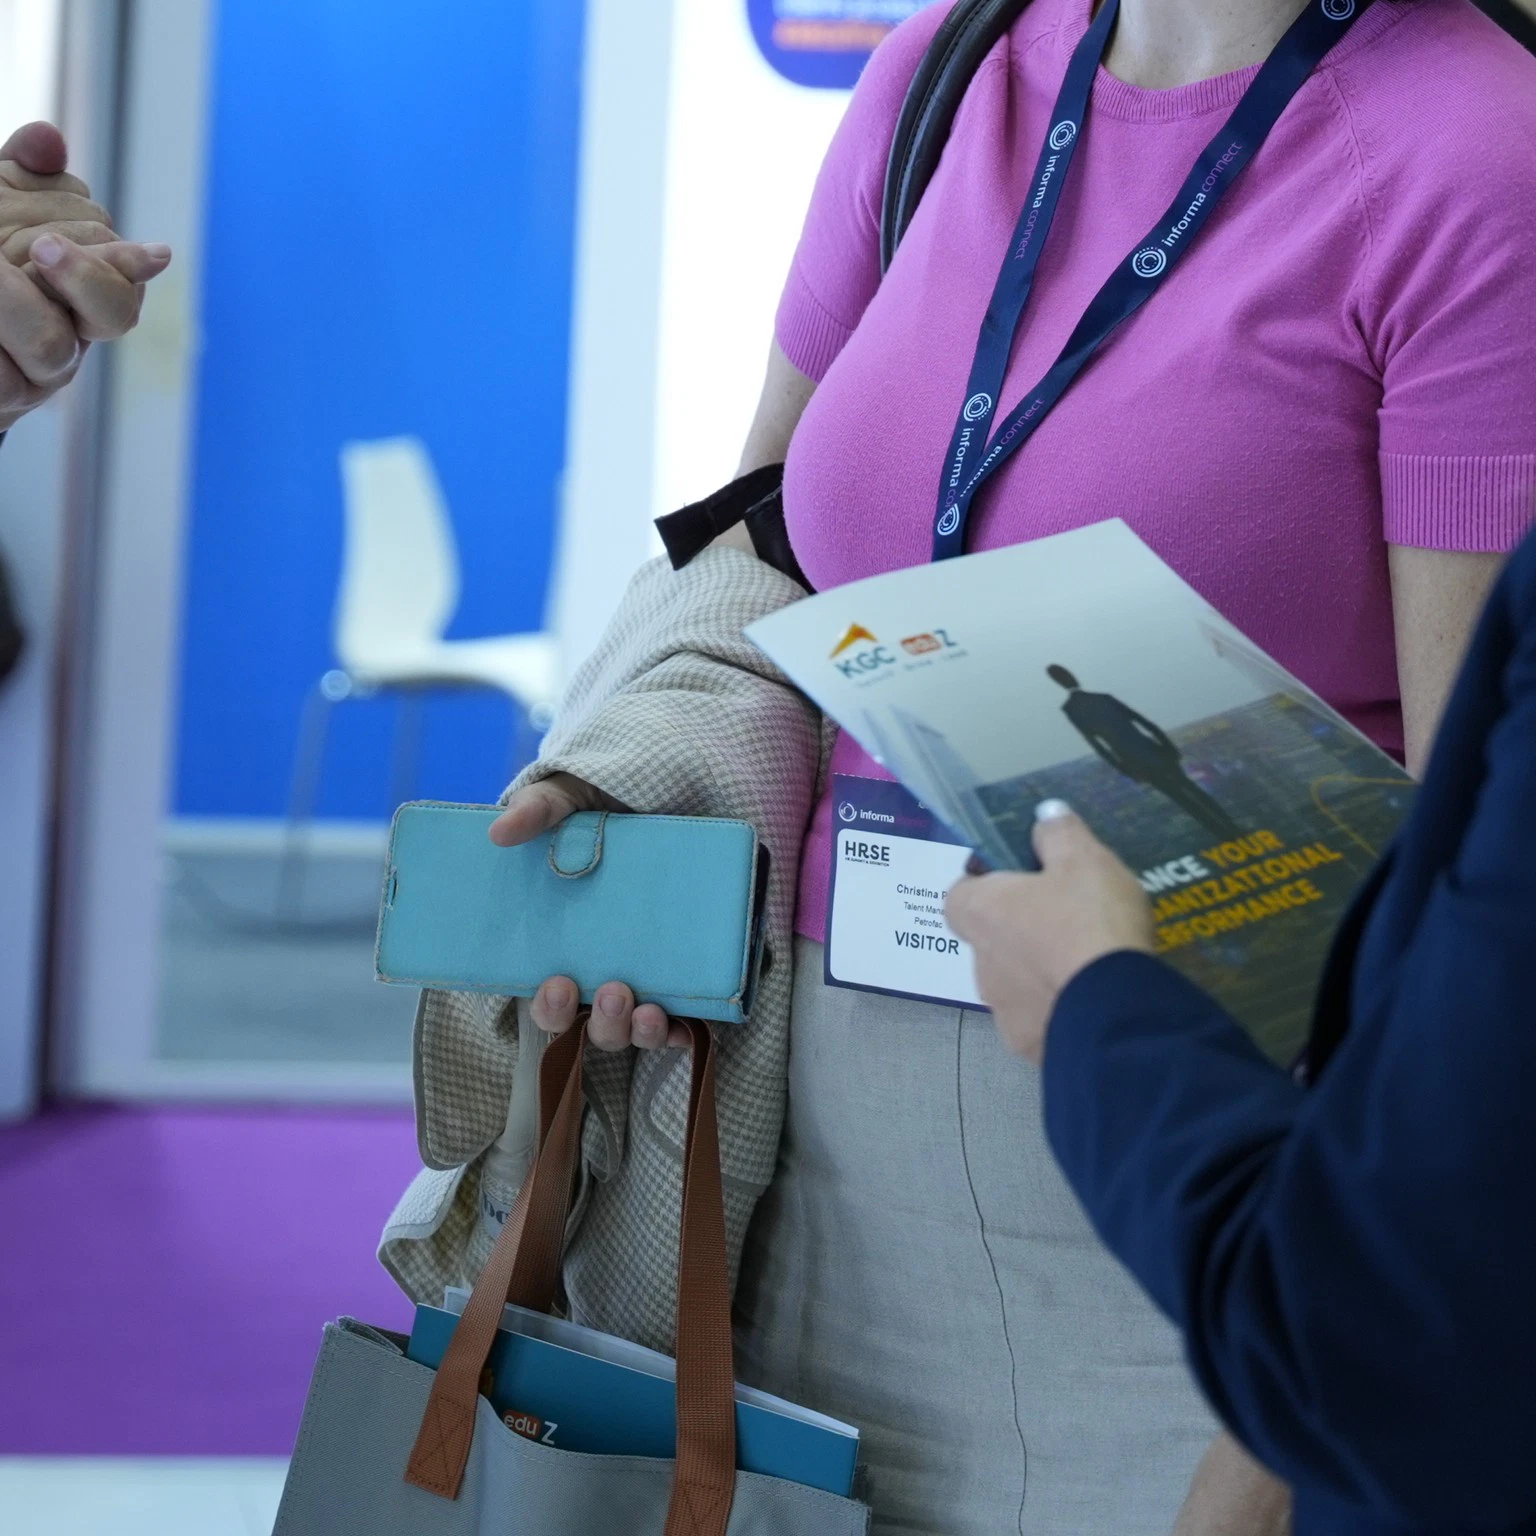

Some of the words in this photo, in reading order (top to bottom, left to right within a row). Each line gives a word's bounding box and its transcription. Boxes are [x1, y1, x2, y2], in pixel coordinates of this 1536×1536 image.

[1032, 154, 1060, 209] informa
[1161, 191, 1207, 247] informa
[1201, 141, 1243, 194] connect
[1015, 209, 1039, 260] connect
[949, 427, 975, 487] informa
[959, 445, 1003, 498] orma
[999, 398, 1044, 445] connect
[835, 645, 897, 679] KGC
[860, 809, 895, 824] informa
[844, 840, 891, 862] HRSE
[1200, 829, 1286, 867] YOUR
[896, 883, 939, 899] Christina
[904, 901, 924, 913] Talent
[914, 916, 943, 929] Petrofac
[894, 930, 959, 955] VISITOR
